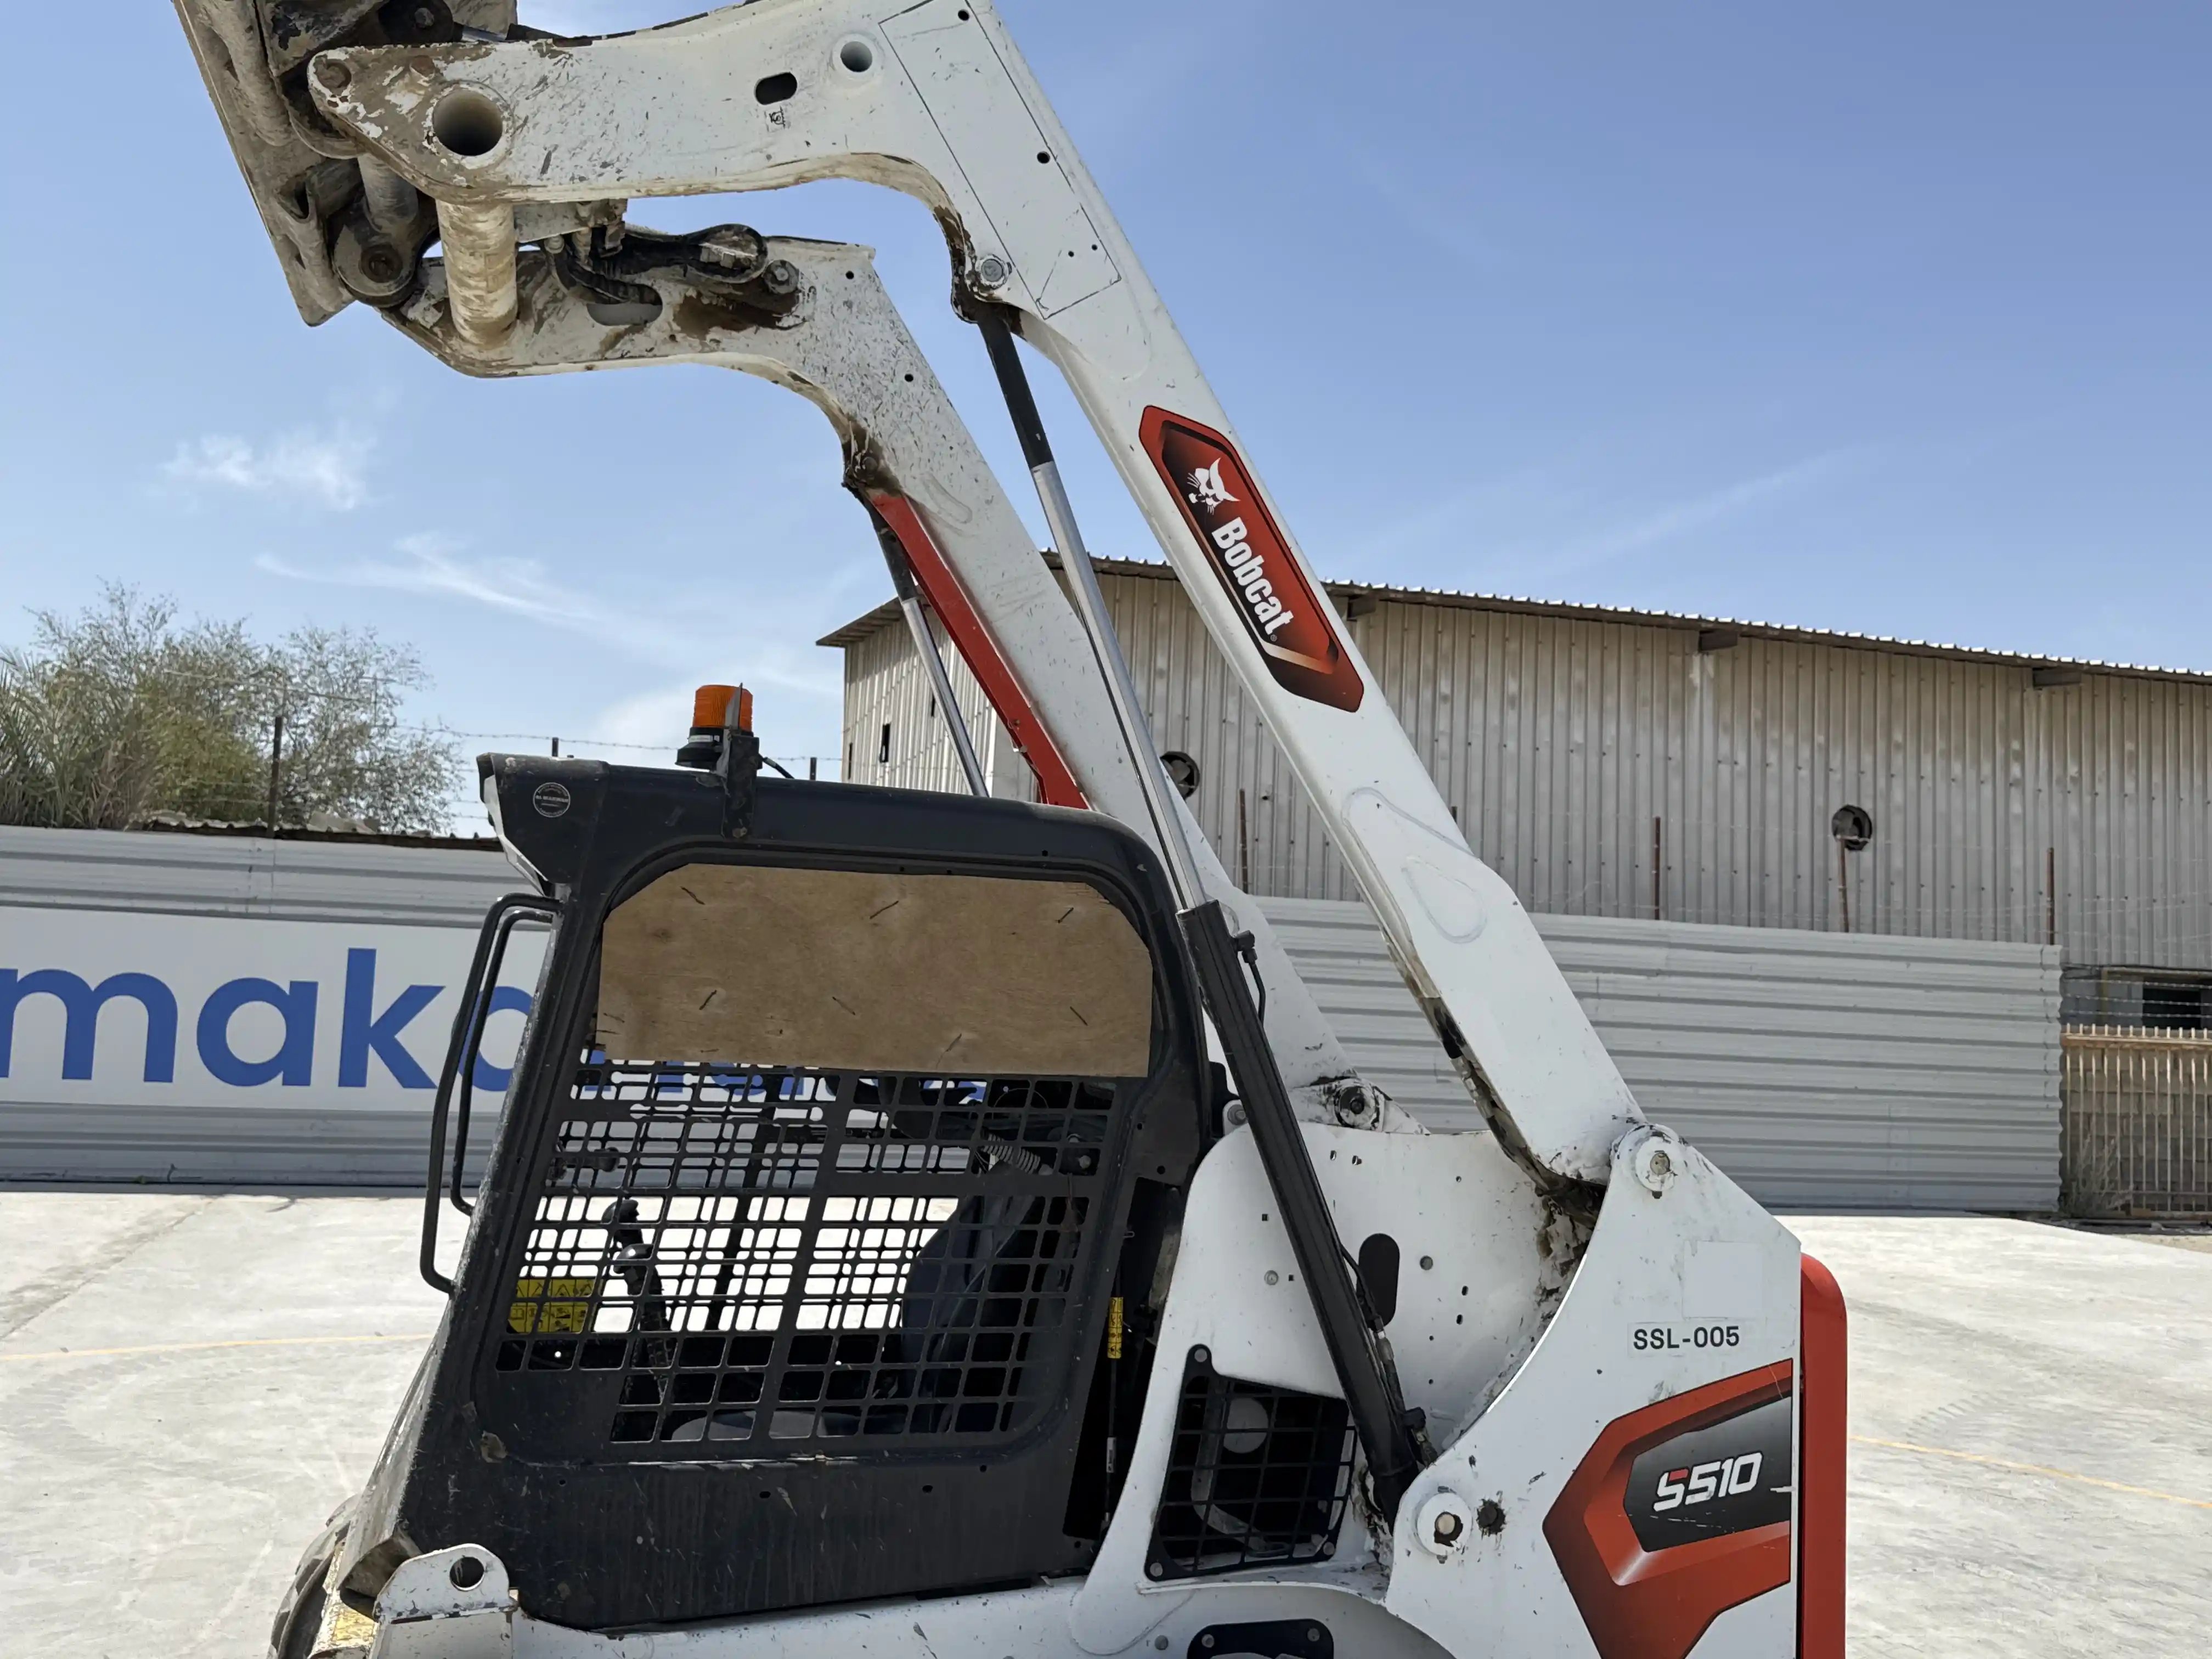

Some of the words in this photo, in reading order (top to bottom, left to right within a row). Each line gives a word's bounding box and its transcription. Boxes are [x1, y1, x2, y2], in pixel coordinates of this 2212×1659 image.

[1211, 516, 1295, 636] Bobcat
[1633, 1325, 1740, 1351] SSL-005
[1653, 1452, 1763, 1512] S510
